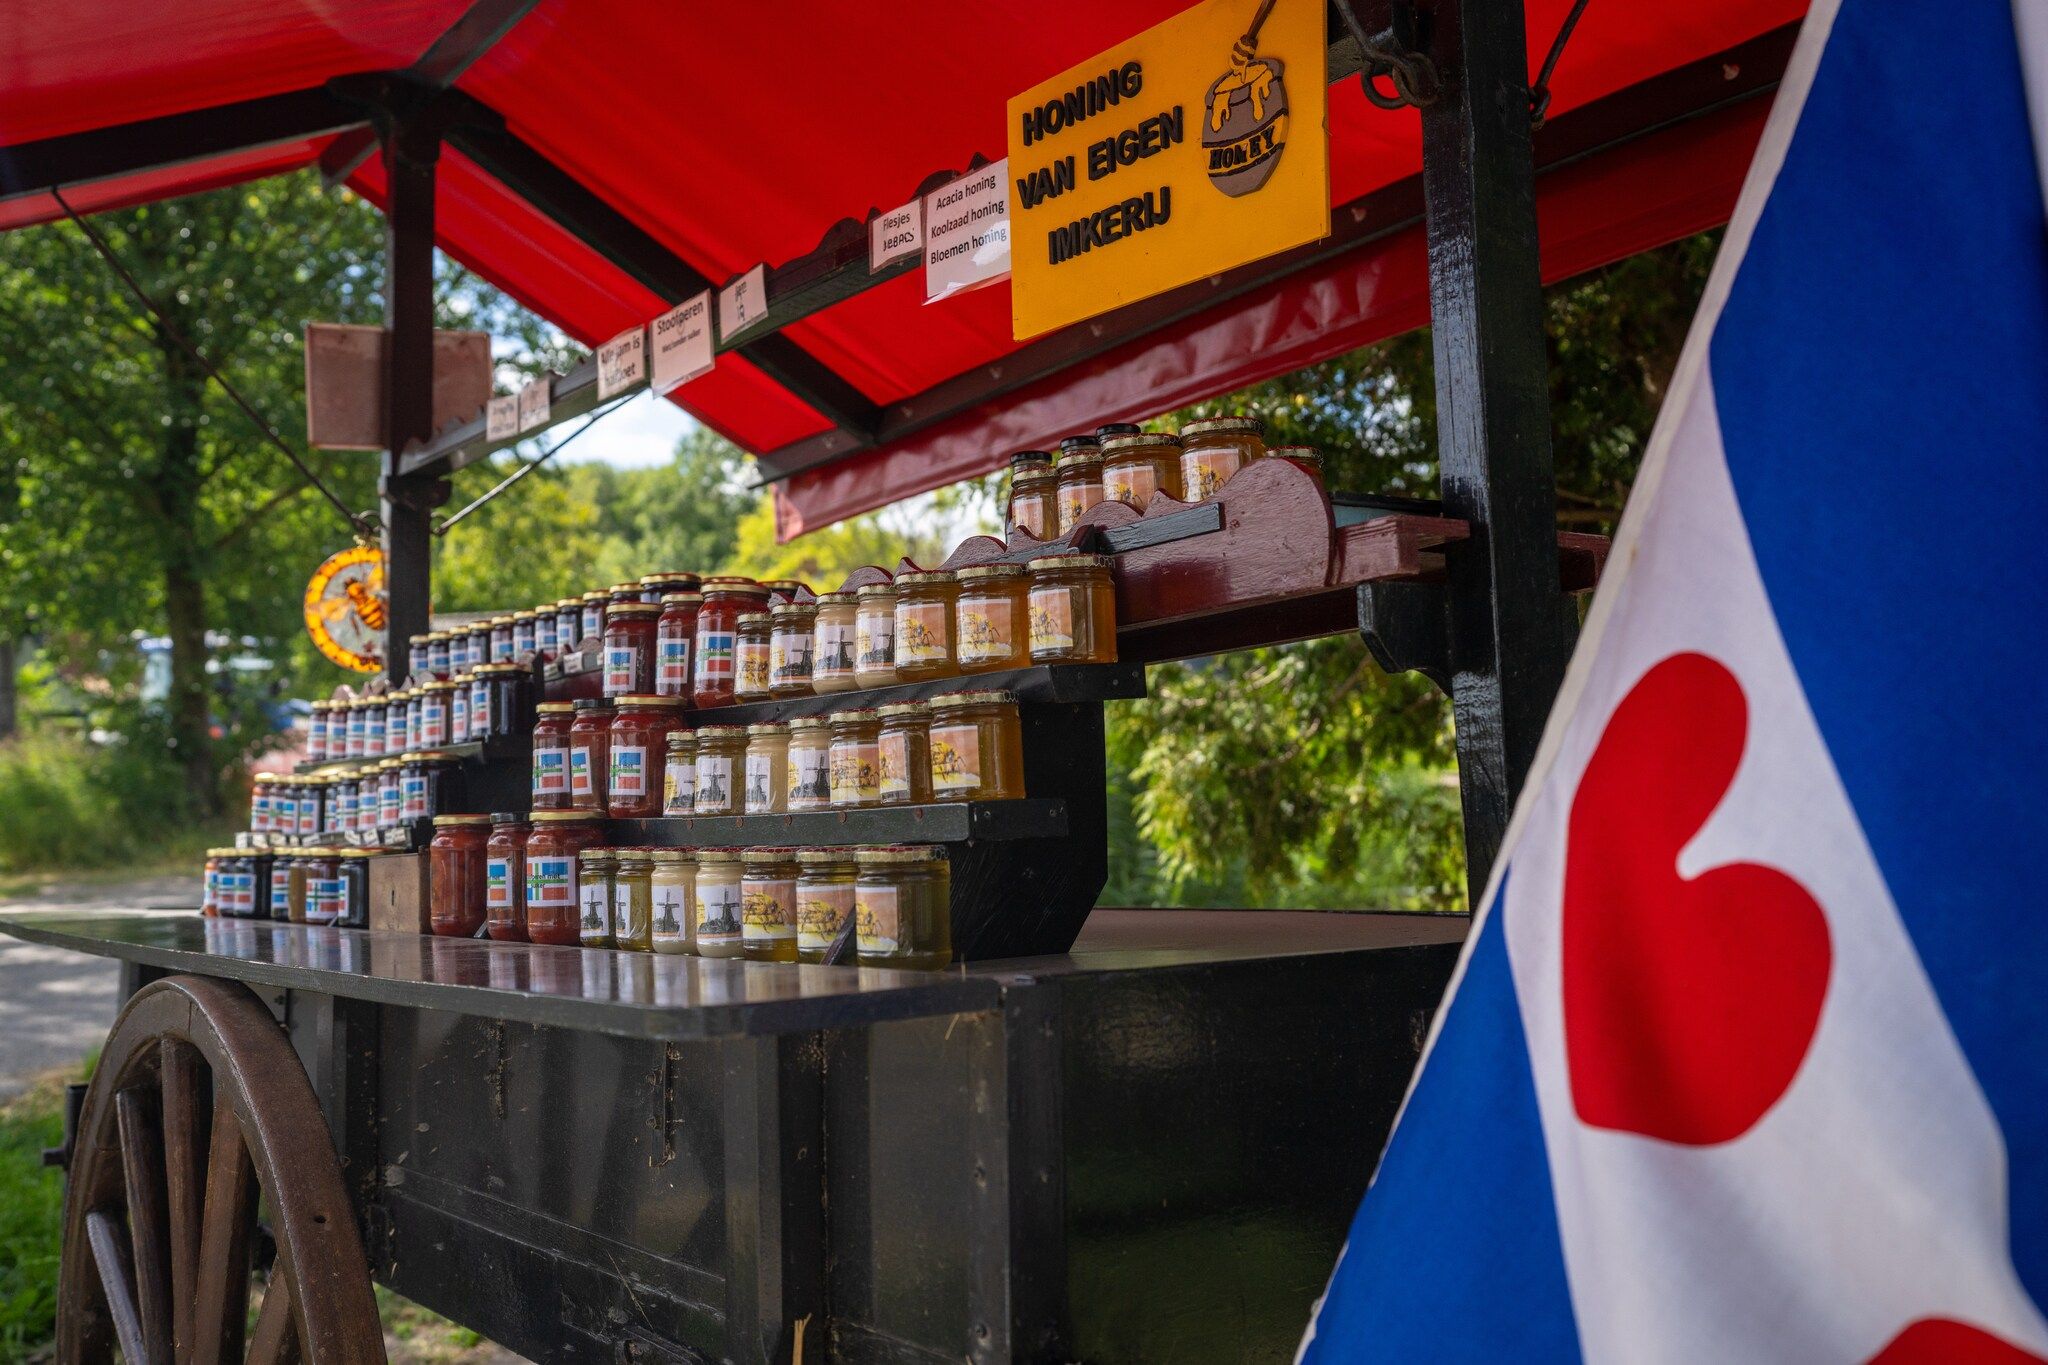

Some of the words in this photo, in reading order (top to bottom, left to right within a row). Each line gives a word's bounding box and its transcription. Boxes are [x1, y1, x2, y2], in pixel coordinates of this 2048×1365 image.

[1022, 61, 1143, 146] HONING
[1016, 156, 1075, 209] VAN
[1088, 105, 1183, 181] EIGEN
[936, 190, 963, 211] Acacia
[965, 175, 996, 198] honing
[931, 211, 969, 239] Koolzaad
[971, 200, 1005, 222] honing
[1048, 186, 1171, 265] IMKERIJ
[930, 241, 970, 265] Bloemen
[971, 228, 1007, 249] honing
[633, 335, 640, 348] is
